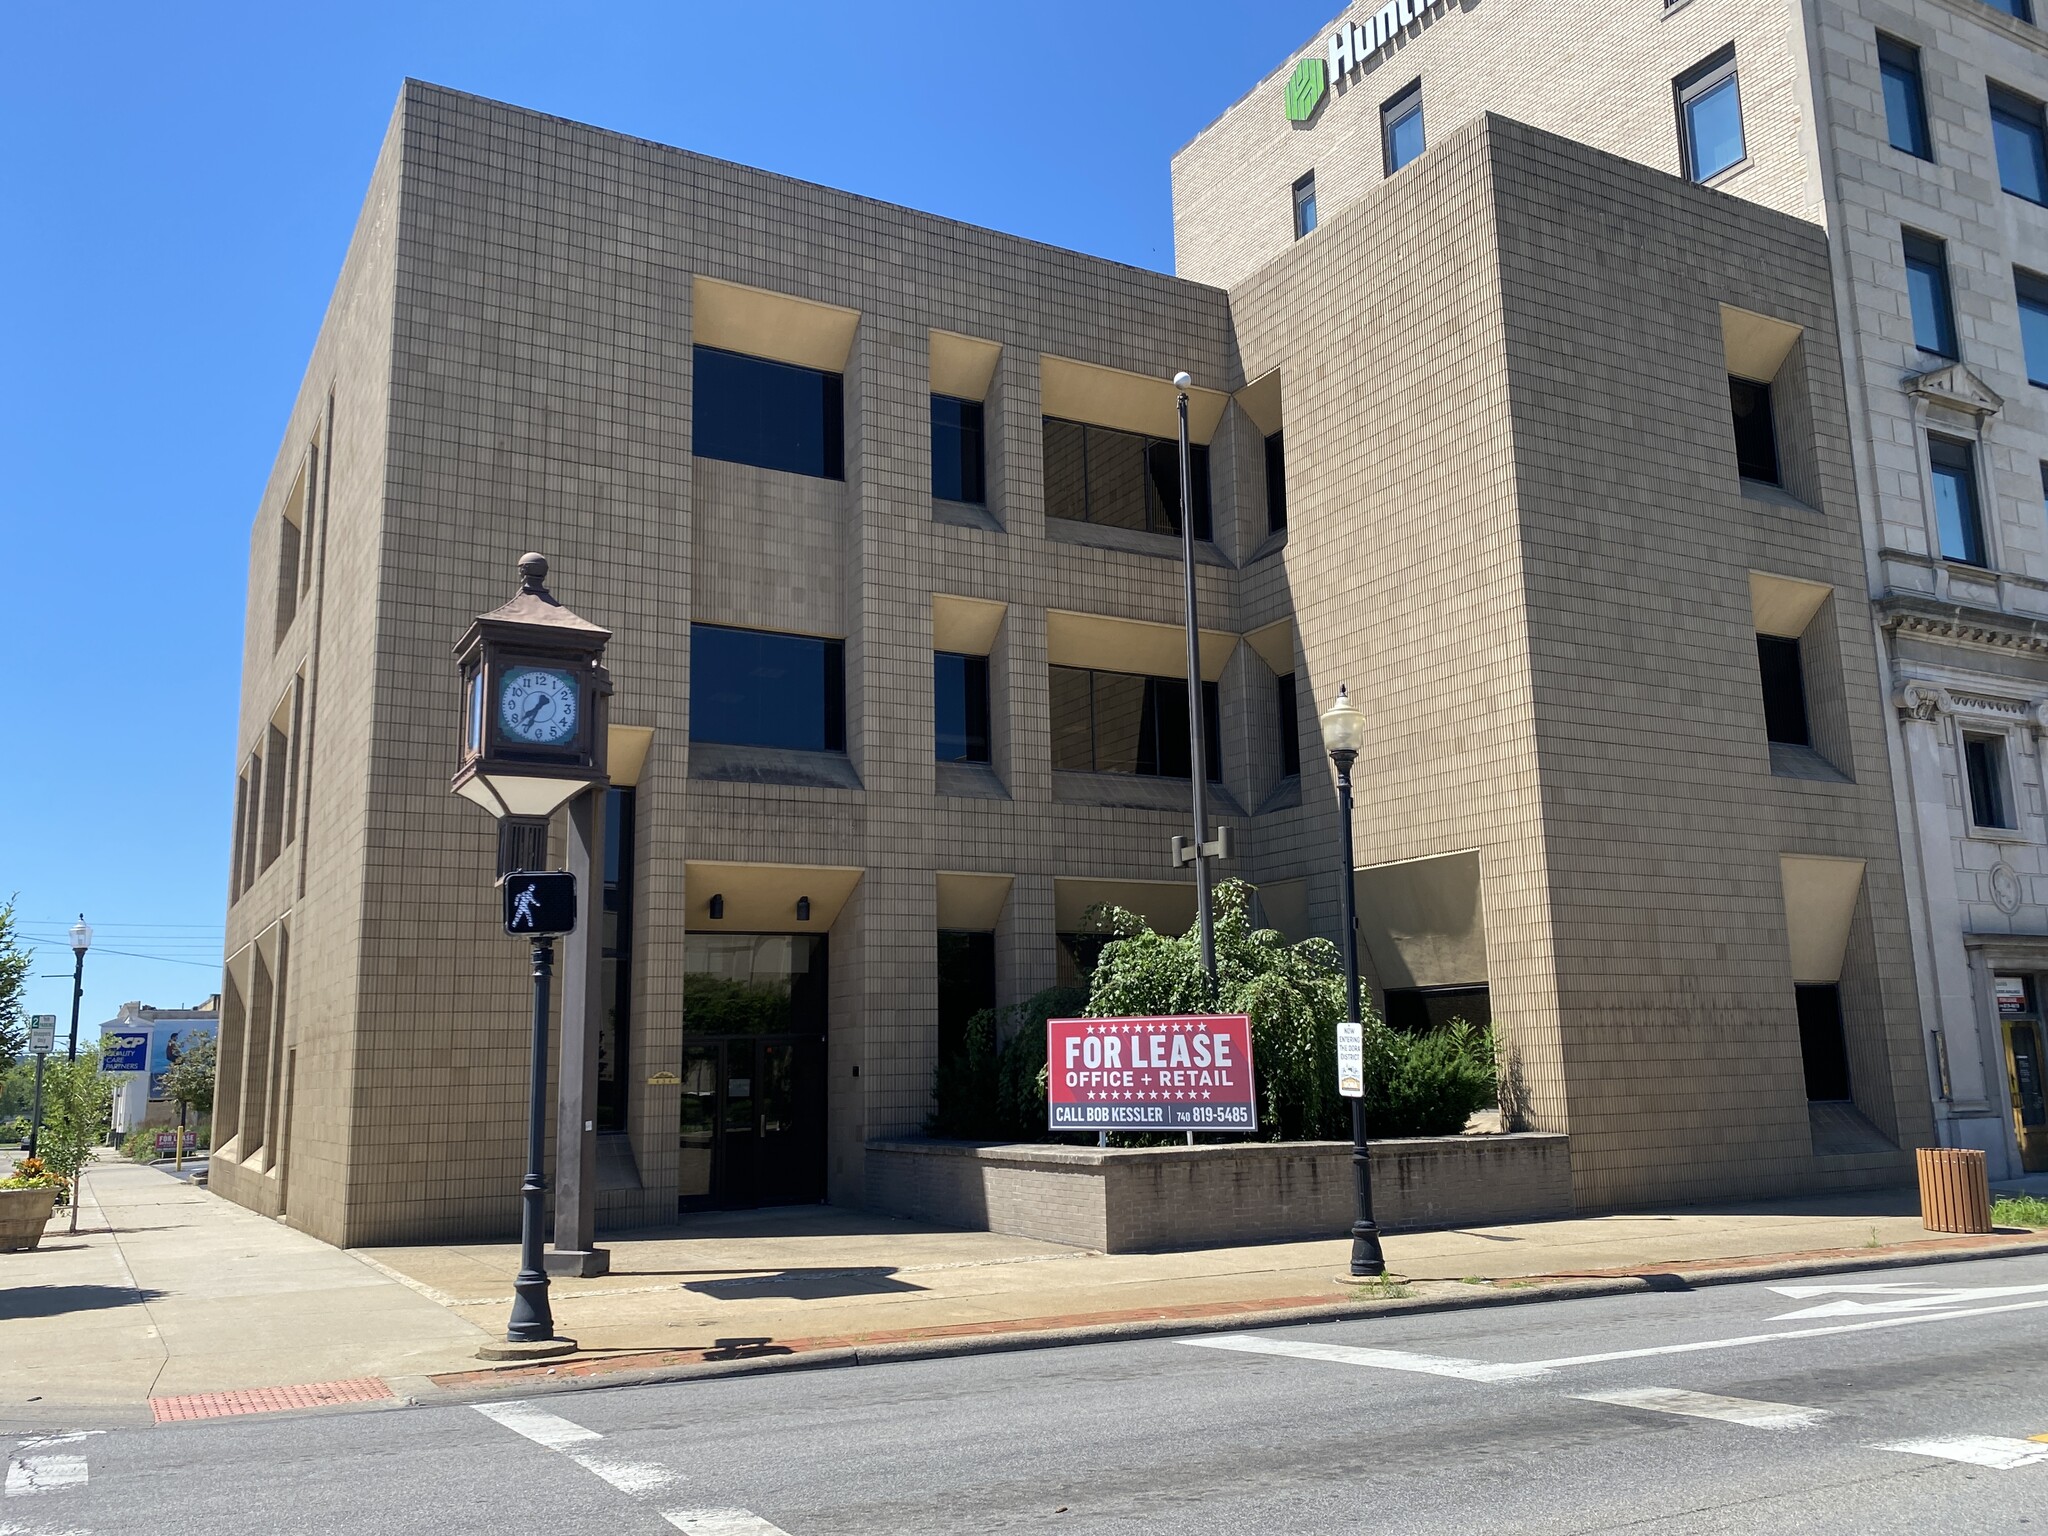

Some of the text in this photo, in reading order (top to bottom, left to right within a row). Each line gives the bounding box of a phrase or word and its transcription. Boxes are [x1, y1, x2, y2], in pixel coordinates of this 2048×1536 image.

[523, 678, 531, 688] 11
[535, 675, 547, 686] 12
[512, 687, 523, 697] 10
[561, 690, 568, 700] 2
[508, 699, 516, 710] 9
[563, 703, 571, 715] 3
[511, 713, 519, 724] 8
[559, 716, 568, 727] 4
[535, 728, 543, 739] 6
[549, 726, 557, 737] 5
[32, 1017, 39, 1027] 2
[1065, 1033, 1232, 1069] FOR LEASE
[1065, 1069, 1234, 1087] OFFICE + RETAIL
[1056, 1106, 1248, 1122] CALL BOB KESSLER 740 819-5485
[173, 1134, 194, 1142] LASE
